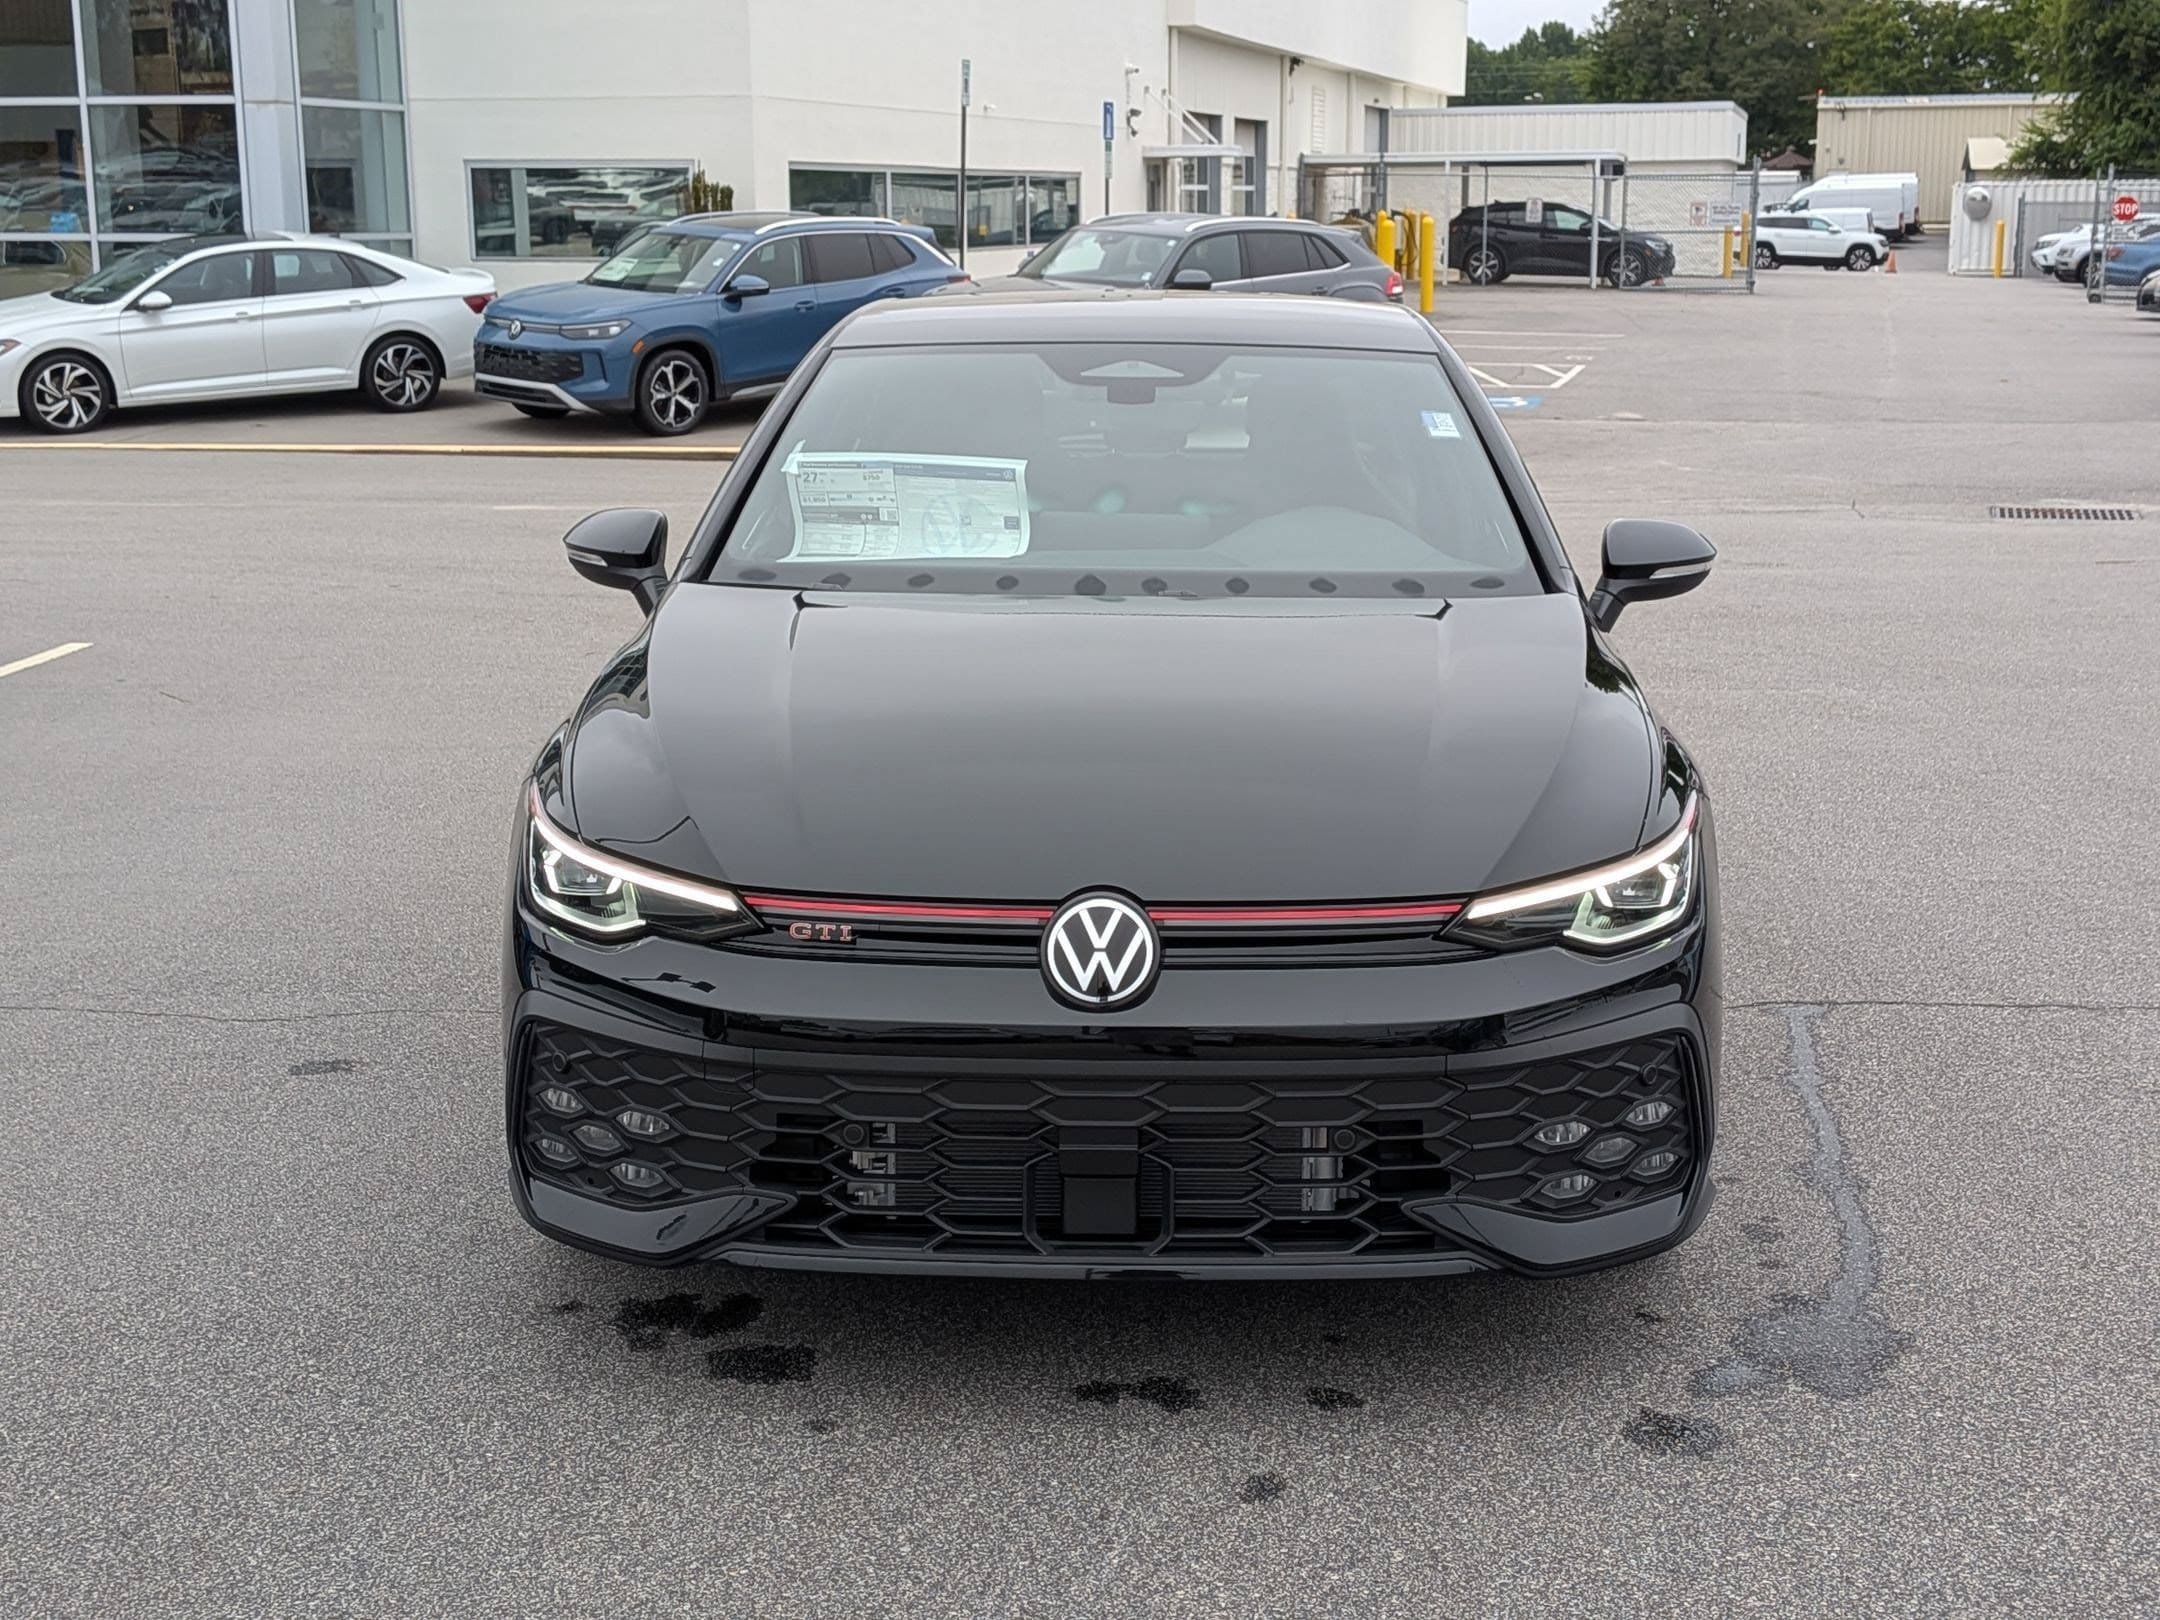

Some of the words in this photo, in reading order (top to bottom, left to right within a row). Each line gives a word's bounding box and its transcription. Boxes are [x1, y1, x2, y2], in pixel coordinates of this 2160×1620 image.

[2113, 203, 2138, 215] STOP
[802, 471, 818, 483] 27
[789, 921, 852, 942] GTI
[1056, 907, 1145, 992] VW
